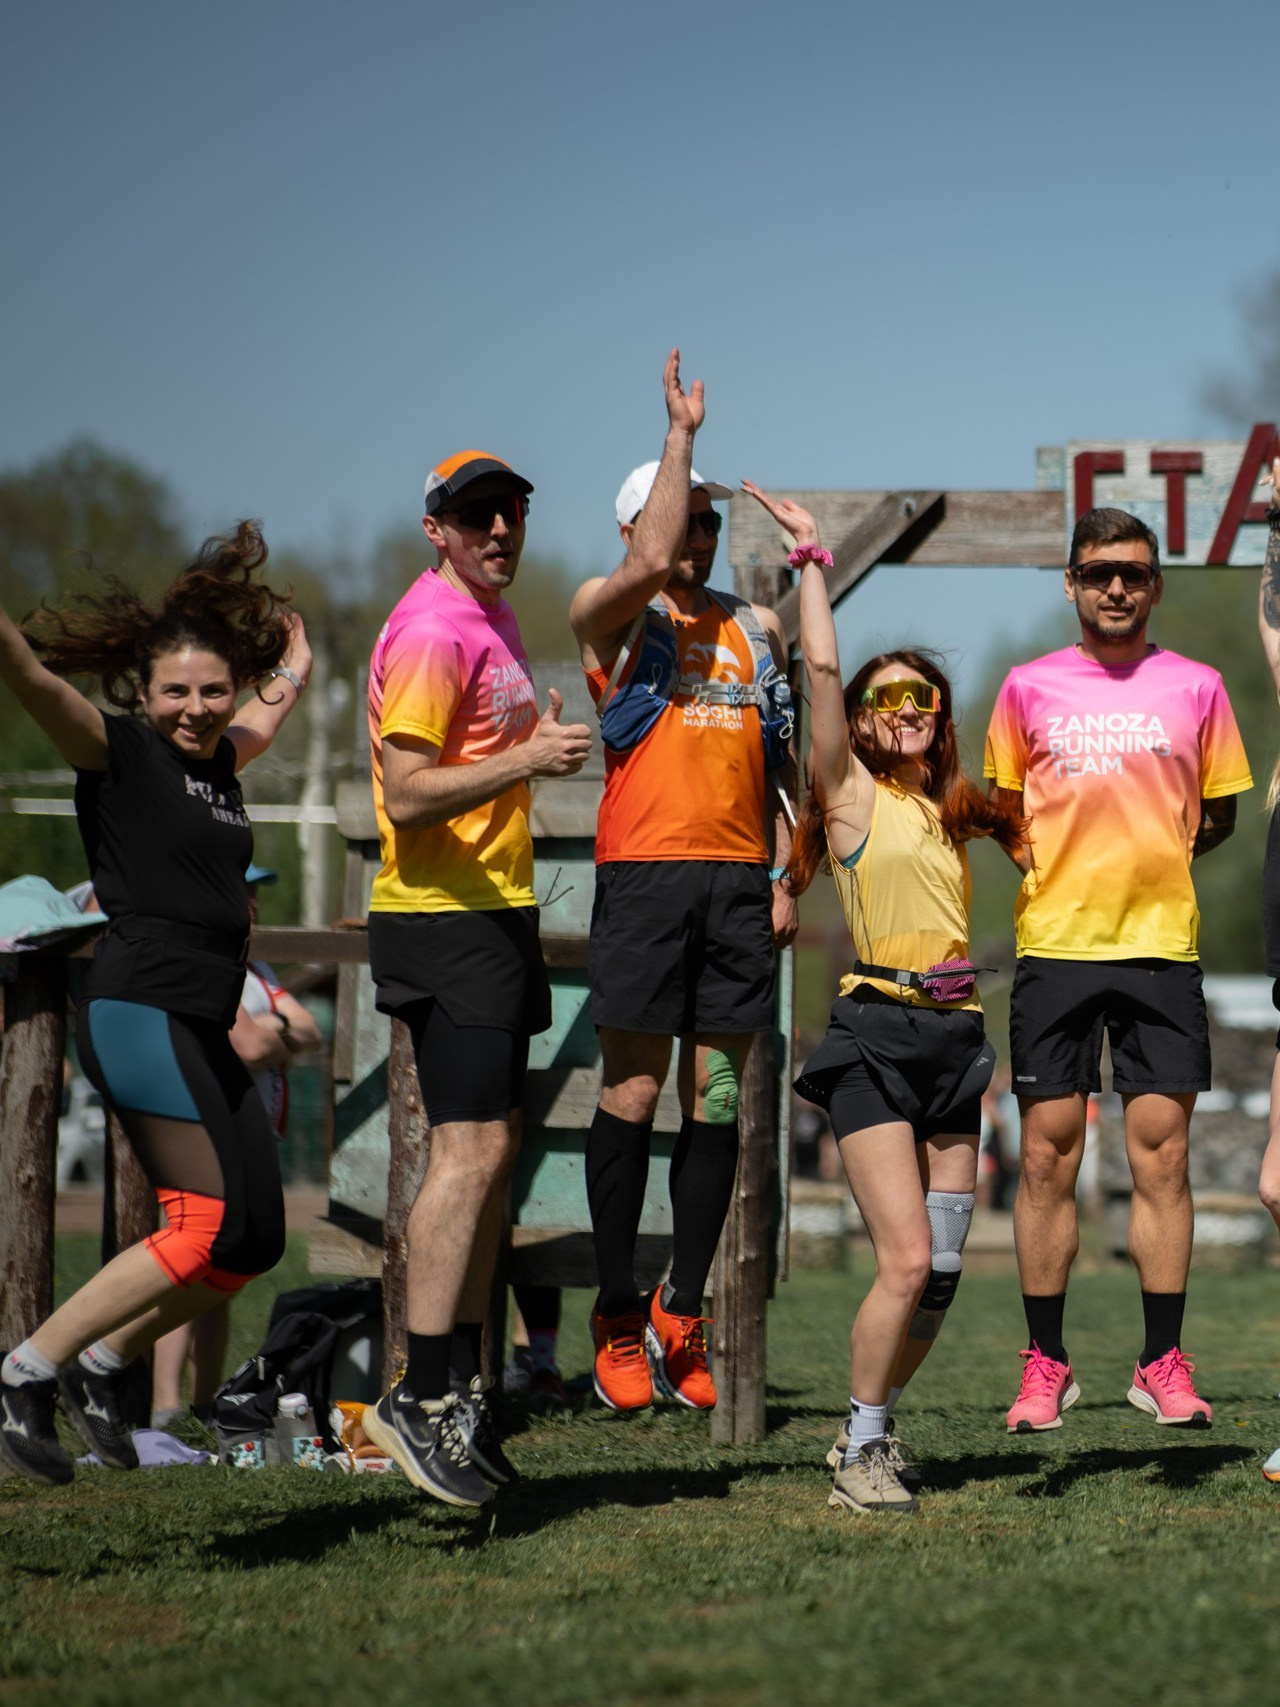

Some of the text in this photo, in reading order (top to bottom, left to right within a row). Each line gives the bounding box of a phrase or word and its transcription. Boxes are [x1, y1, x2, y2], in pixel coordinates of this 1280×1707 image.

[683, 701, 743, 720] SOCHI
[683, 717, 743, 731] MARATHON
[1046, 713, 1165, 738] ZANOZA
[1047, 734, 1172, 759] RUNNING
[1052, 756, 1123, 780] TEAM
